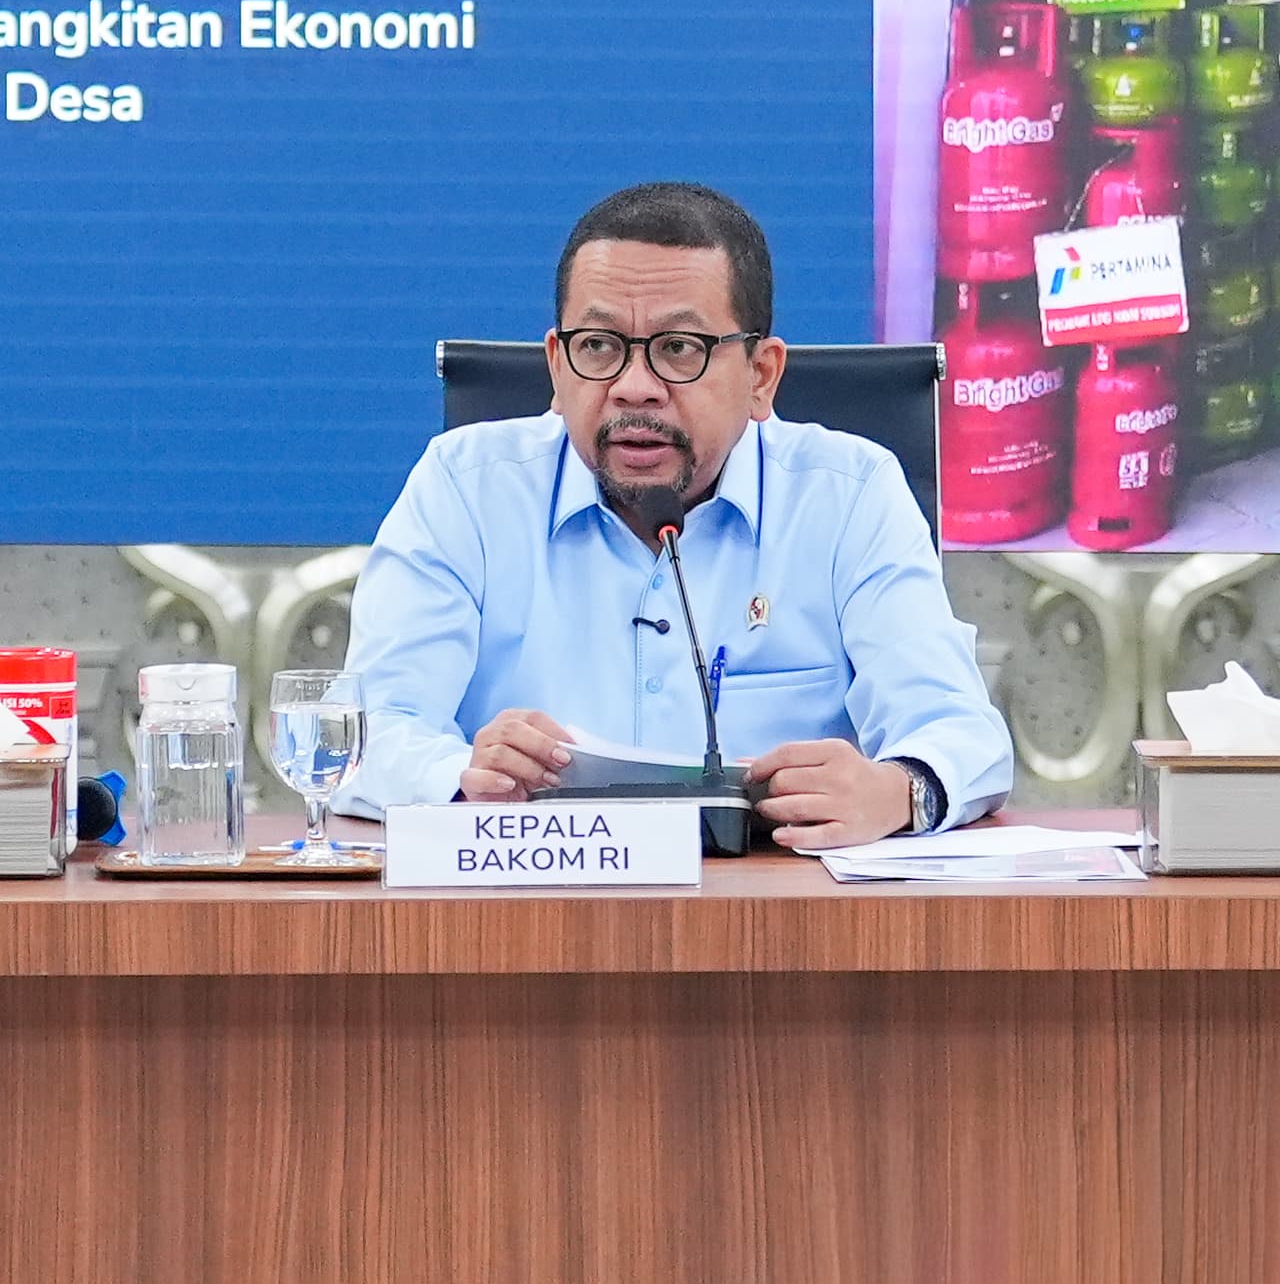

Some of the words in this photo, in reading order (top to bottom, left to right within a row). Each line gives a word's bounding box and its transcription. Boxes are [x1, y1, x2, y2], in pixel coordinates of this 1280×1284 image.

[241, 0, 474, 48] Ekonomi
[7, 73, 142, 121] Desa
[1090, 253, 1172, 280] PERTAMINA
[18, 697, 43, 709] 50%
[475, 814, 612, 840] KEPALA
[457, 847, 585, 872] BAKOM
[599, 846, 629, 870] RI
